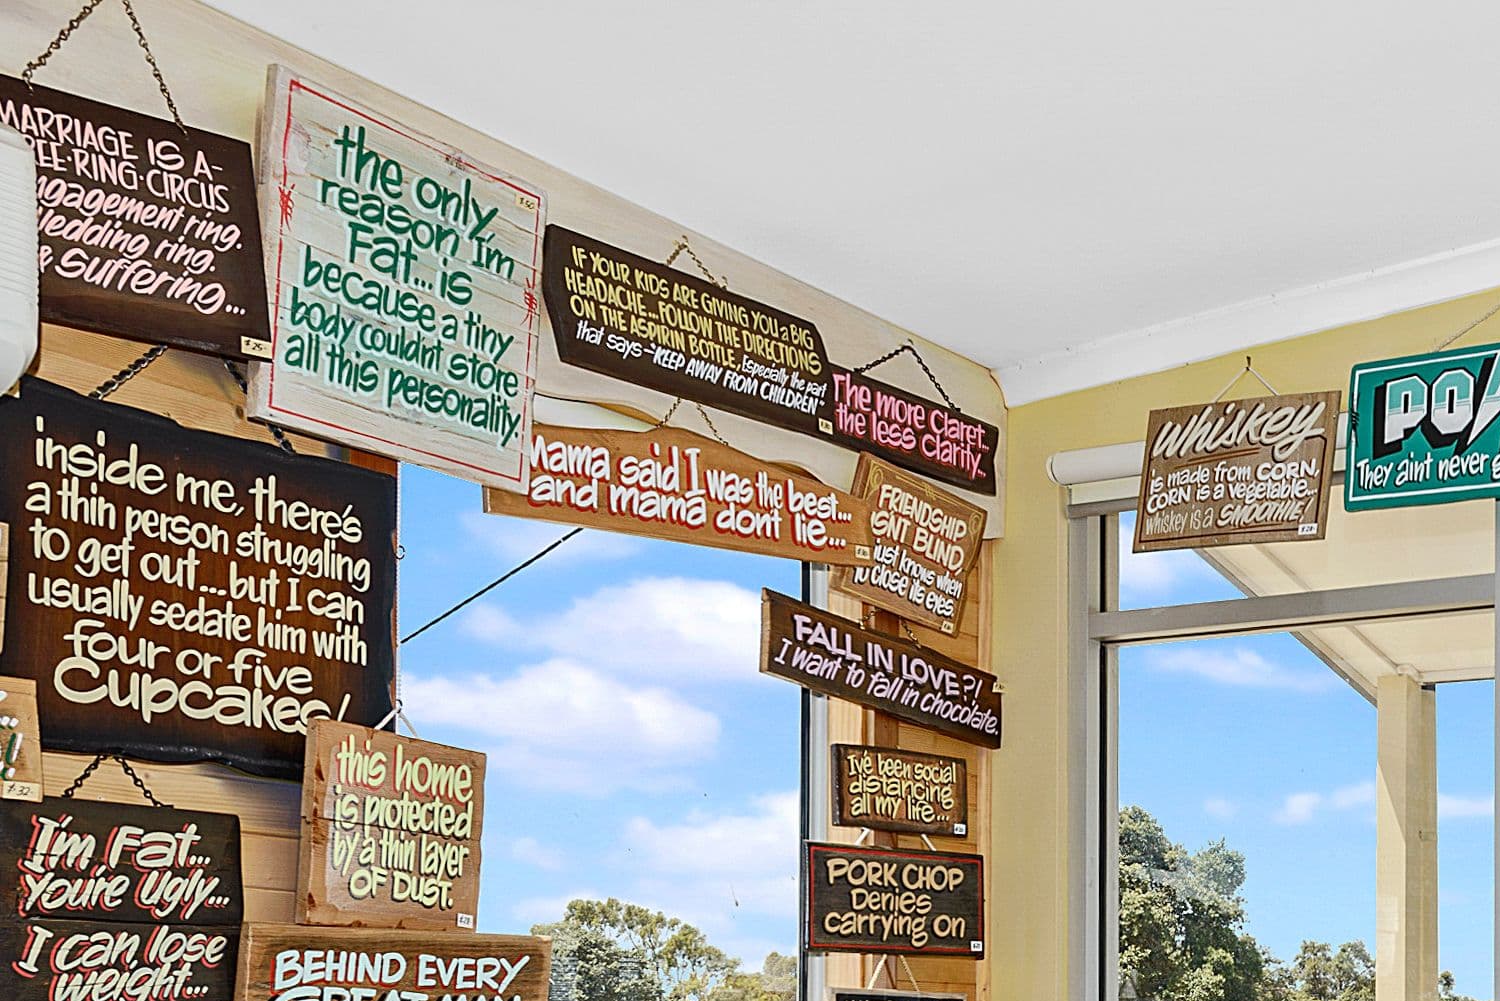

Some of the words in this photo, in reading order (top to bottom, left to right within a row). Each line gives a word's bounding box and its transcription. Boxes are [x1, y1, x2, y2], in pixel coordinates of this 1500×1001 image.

[0, 100, 139, 161] MARRIAGE
[147, 140, 182, 168] IS
[335, 126, 402, 197] the
[416, 168, 499, 240] only
[318, 179, 458, 256] reason
[474, 232, 514, 279] I'm
[572, 245, 587, 269] IF
[588, 252, 630, 286] YOUR
[635, 268, 670, 299] KIDS
[673, 282, 698, 307] ARE
[701, 287, 749, 326] GIVING
[750, 310, 779, 337] YOU
[781, 324, 789, 340] a
[790, 323, 813, 348] BIG
[833, 372, 870, 410] The
[874, 388, 923, 429] more
[836, 402, 865, 437] the
[871, 413, 915, 453] less
[35, 416, 168, 494] inside
[177, 472, 244, 516] me,
[248, 475, 362, 542] there's
[532, 473, 598, 514] and
[610, 485, 707, 526] mama
[620, 443, 679, 491] said
[686, 446, 702, 495] I
[706, 468, 753, 505] was
[755, 472, 783, 512] the
[1356, 459, 1393, 492] They
[1438, 452, 1488, 483] never
[793, 613, 858, 663] FALL
[867, 638, 893, 674] IN
[336, 734, 388, 787] this
[395, 745, 473, 796] home
[849, 774, 954, 809] distancing
[877, 752, 911, 780] been
[913, 761, 957, 783] social
[31, 813, 95, 868] I'm
[827, 857, 897, 888] PORK
[902, 863, 964, 892] CHOP
[824, 909, 929, 947] carrying
[934, 915, 965, 940] on
[273, 951, 403, 990] BEHIND
[418, 955, 529, 992] EVERY
